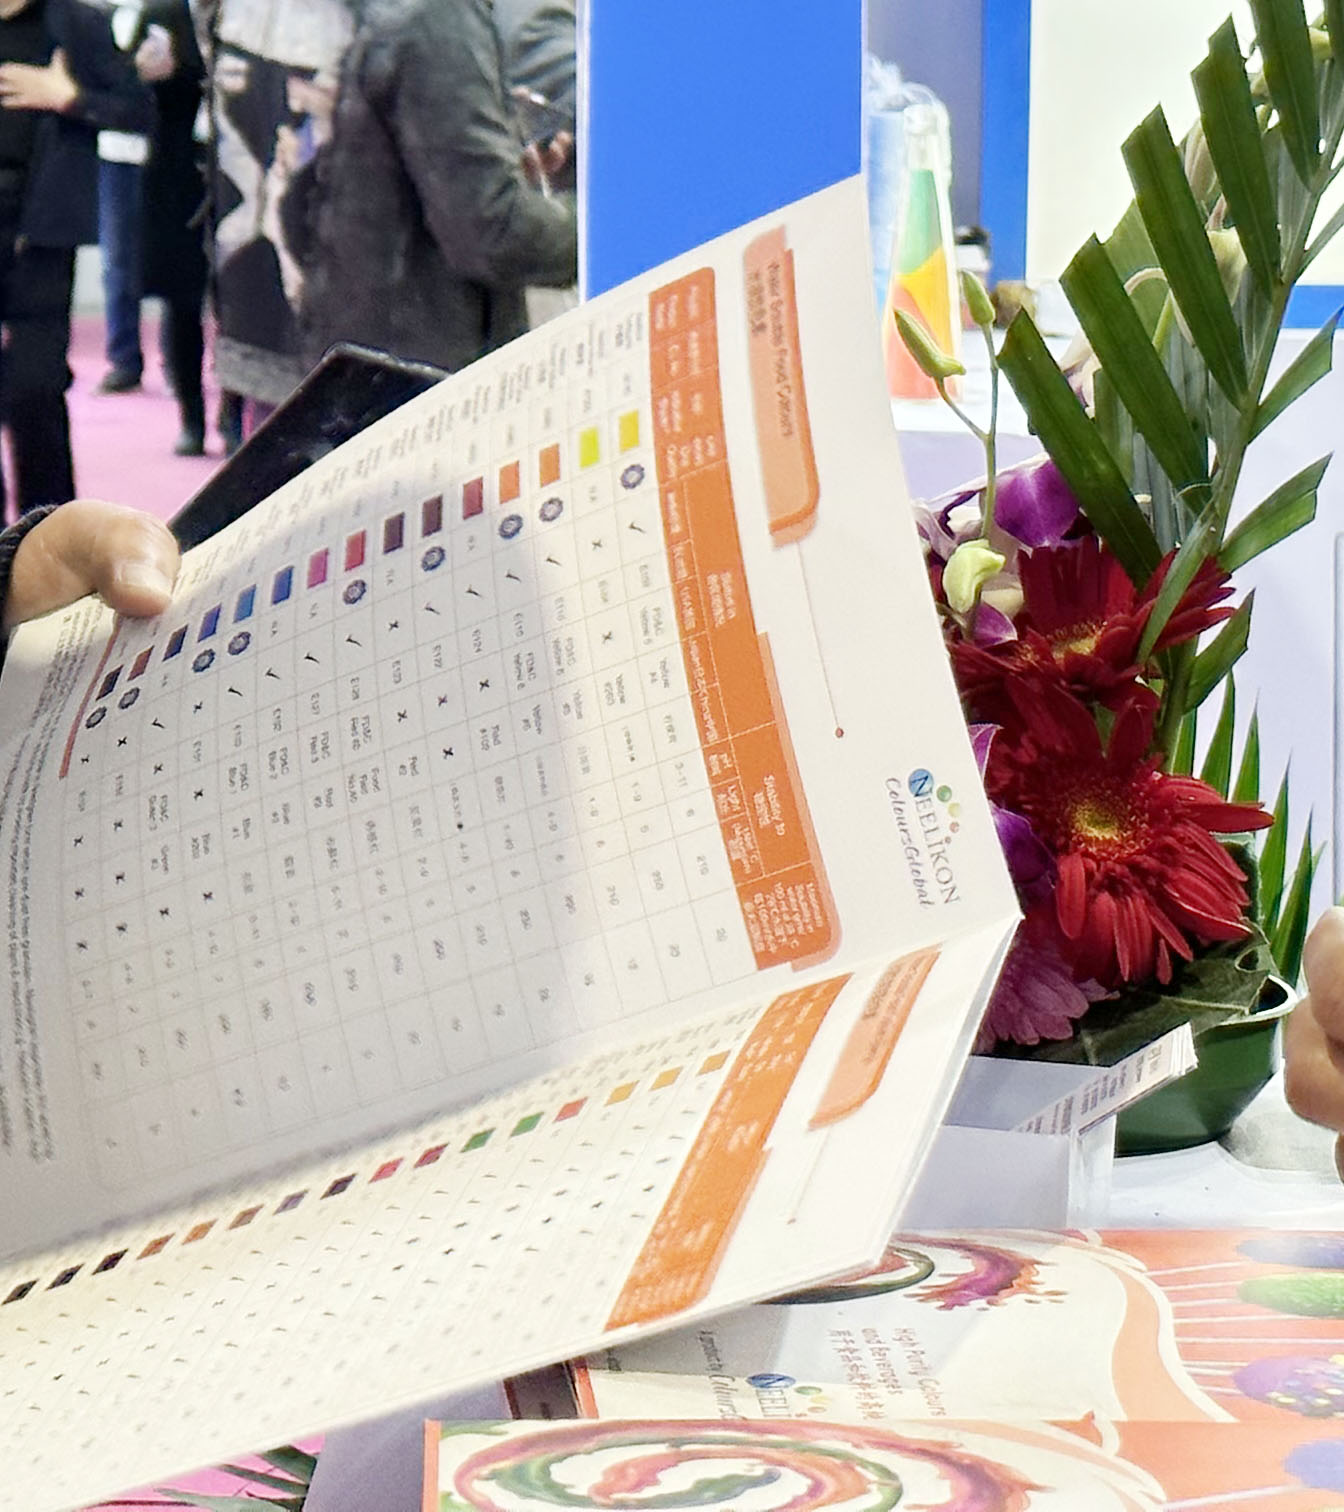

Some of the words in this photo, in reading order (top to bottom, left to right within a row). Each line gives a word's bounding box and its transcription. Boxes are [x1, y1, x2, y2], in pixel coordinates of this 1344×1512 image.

[763, 775, 783, 821] Stability
[910, 774, 960, 906] NEELIKON
[868, 1347, 904, 1395] Beverages
[917, 1378, 947, 1416] Colours
